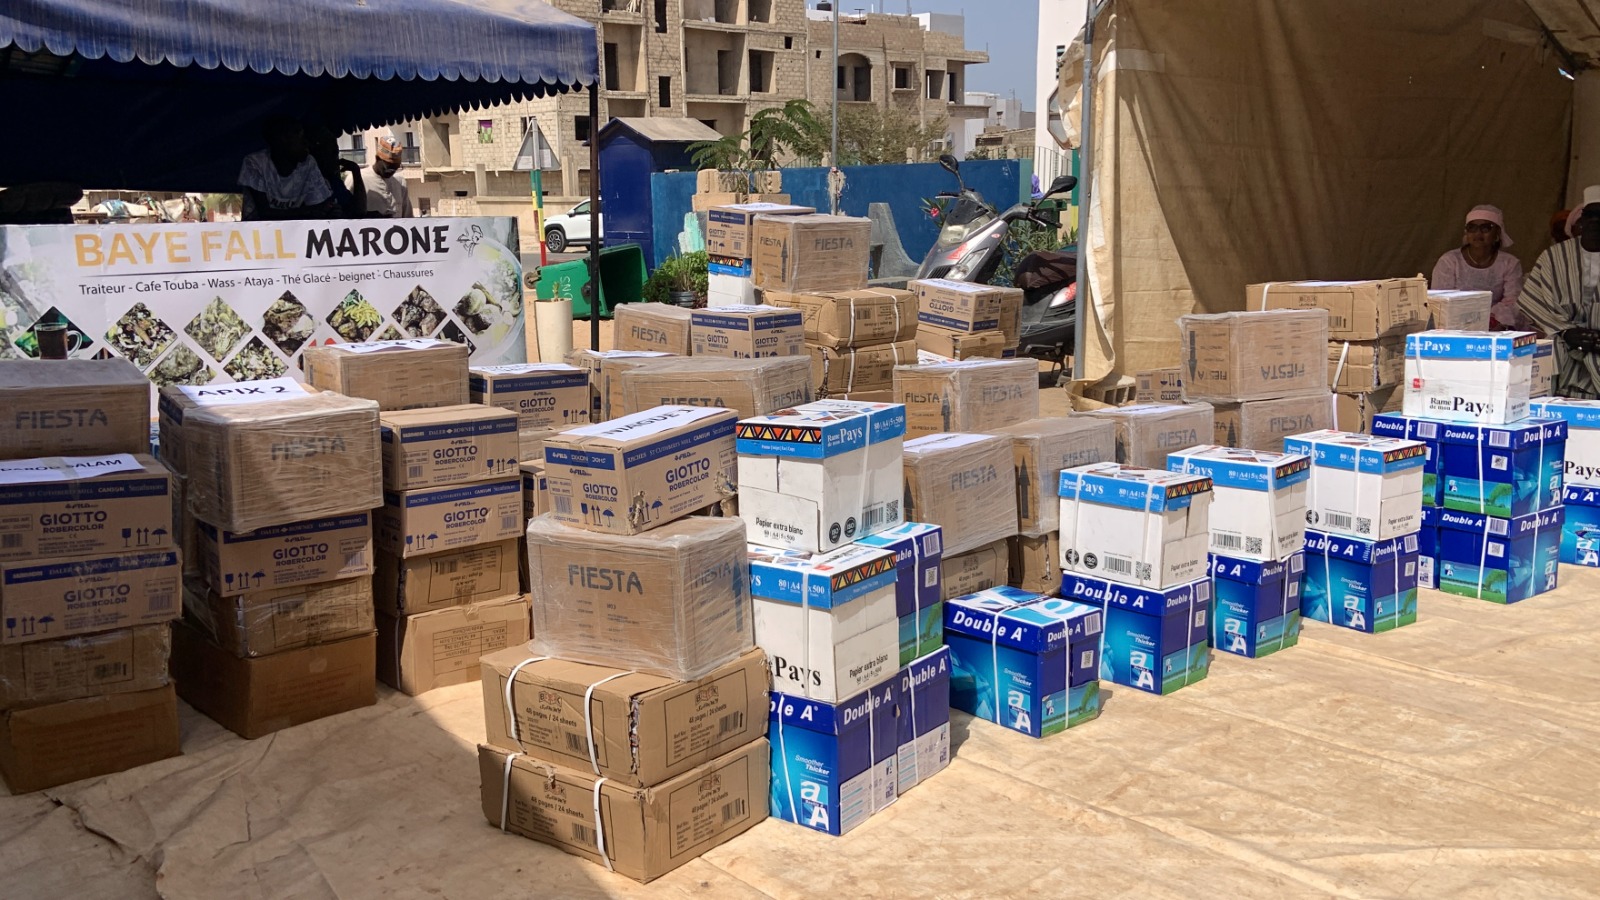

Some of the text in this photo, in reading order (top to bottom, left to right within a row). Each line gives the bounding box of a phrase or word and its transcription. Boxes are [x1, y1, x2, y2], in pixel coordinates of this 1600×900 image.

[74, 224, 450, 267] BAYE FALL MARONE
[760, 236, 782, 248] FIESTA
[815, 237, 854, 250] FIESTA
[79, 268, 434, 296] Traiteur Cafe Touba Wass Ataya Thé Glacé beignet Chaussures
[930, 302, 954, 312] GIOTTO
[632, 325, 668, 344] FIESTA
[707, 334, 729, 344] GIOTTO
[755, 336, 778, 345] GIOTTO
[1424, 341, 1450, 354] Pays
[1198, 370, 1227, 380] FIESTA
[1260, 363, 1305, 380] FIESTA
[198, 386, 264, 396] APIX
[905, 392, 940, 403] FIESTA
[520, 397, 556, 408] GIOTTO
[773, 388, 802, 409] FIESTA
[1430, 396, 1494, 417] Rame Pays
[16, 409, 108, 430] FIESTA
[1269, 414, 1313, 433] FIESTA
[1375, 422, 1404, 431] Double
[840, 427, 862, 444] Pays
[1157, 428, 1197, 448] FIESTA
[1445, 430, 1475, 440] Double
[1554, 425, 1560, 437] A
[271, 434, 346, 460] FIESTA
[433, 445, 477, 459] GIOTTO
[435, 456, 476, 465] ROBERCOLOR
[1062, 448, 1100, 465] FIESTA
[666, 458, 710, 483] GIOTTO
[1186, 463, 1213, 477] Pays
[1564, 461, 1600, 479] Pays
[669, 472, 710, 492] ROBERCOLOR
[951, 464, 997, 491] FIESTA
[583, 483, 618, 496] GIOTTO
[1079, 479, 1104, 496] Pays
[585, 494, 617, 502] ROBERCOLOR
[1583, 492, 1594, 502] A
[40, 511, 107, 526] GIOTTO
[444, 507, 488, 522] GIOTTO
[1442, 513, 1482, 527] Double A
[1551, 513, 1557, 523] A
[43, 524, 104, 534] ROBERCOLOR
[446, 518, 486, 529] ROBERCOLOR
[756, 517, 803, 535] Papier extra blanc
[273, 543, 328, 560] GIOTTO
[896, 549, 912, 562] uble
[1343, 544, 1354, 556] A
[276, 554, 326, 567] ROBERCOLOR
[695, 562, 731, 587] FIESTA
[1230, 564, 1241, 577] A
[1263, 564, 1283, 577] Double
[568, 564, 644, 595] FIESTA
[778, 579, 800, 590] 80 A4
[64, 584, 130, 602] GIOTTO
[1073, 583, 1144, 608] Double A
[67, 597, 127, 610] ROBERCOLOR
[1166, 594, 1188, 608] Double
[953, 611, 1022, 641] Double A
[1075, 624, 1081, 633] A
[1135, 637, 1156, 646] Thicker
[775, 655, 821, 688] Pays
[850, 666, 863, 678] Papier
[864, 660, 876, 670] extra
[876, 654, 888, 665] blanc
[902, 666, 936, 693] Double
[939, 658, 946, 672] A
[800, 705, 813, 721] A
[843, 687, 892, 725] Double A
[532, 710, 548, 720] pages
[560, 717, 577, 727] sheets
[695, 712, 706, 722] pages
[795, 755, 824, 768] Smoother
[806, 764, 830, 775] Thicker
[538, 798, 554, 809] pages
[566, 807, 584, 818] sheets
